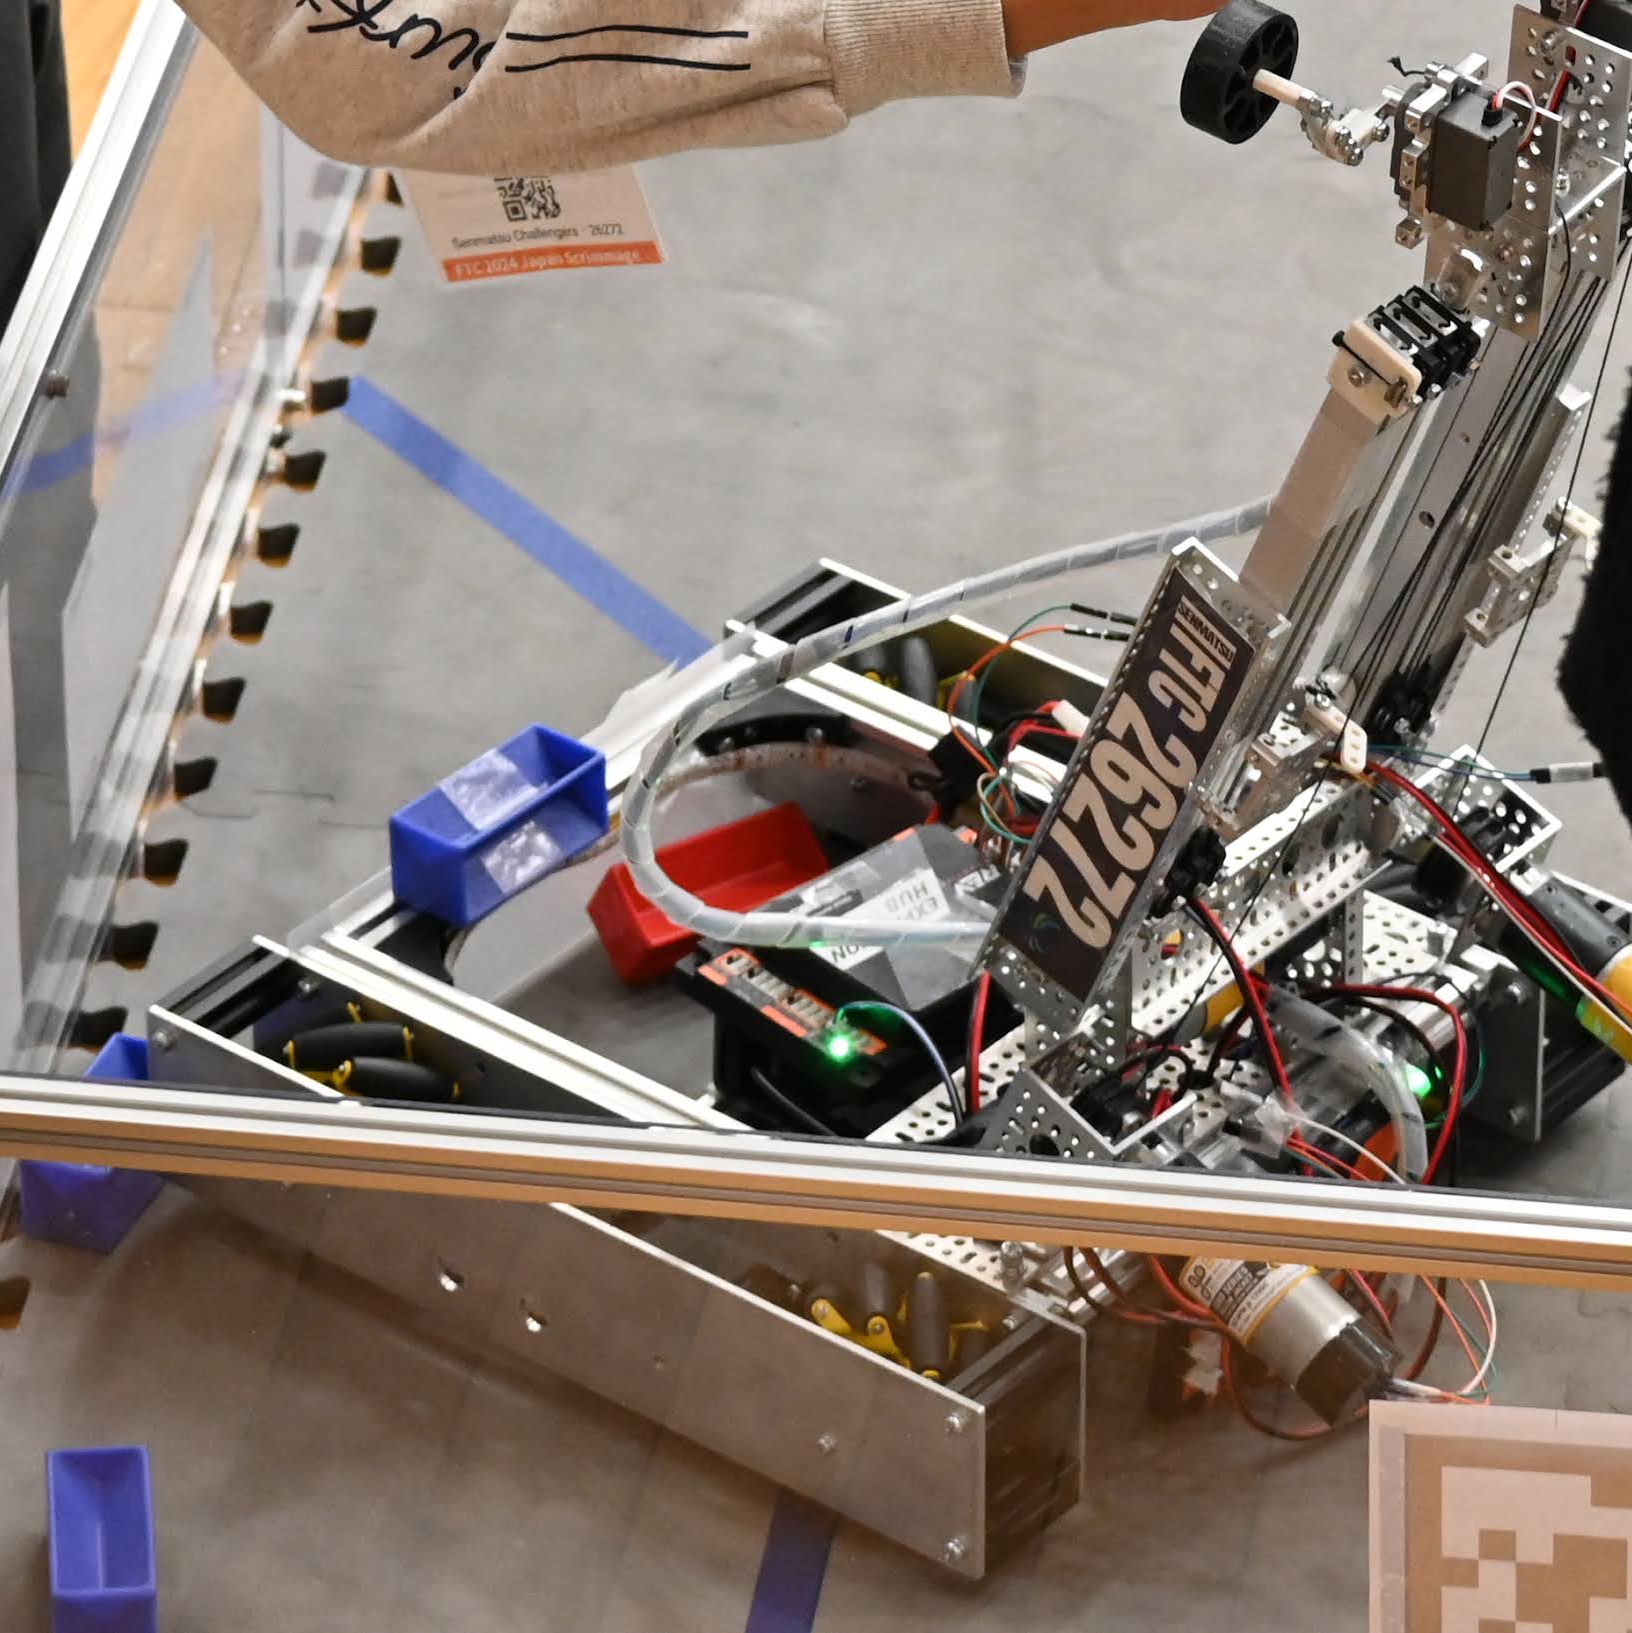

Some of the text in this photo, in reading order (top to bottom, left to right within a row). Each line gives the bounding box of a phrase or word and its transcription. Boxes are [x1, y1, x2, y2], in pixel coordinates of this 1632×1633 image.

[1177, 600, 1234, 663] SENMATSU
[1022, 622, 1226, 949] FTC 26272
